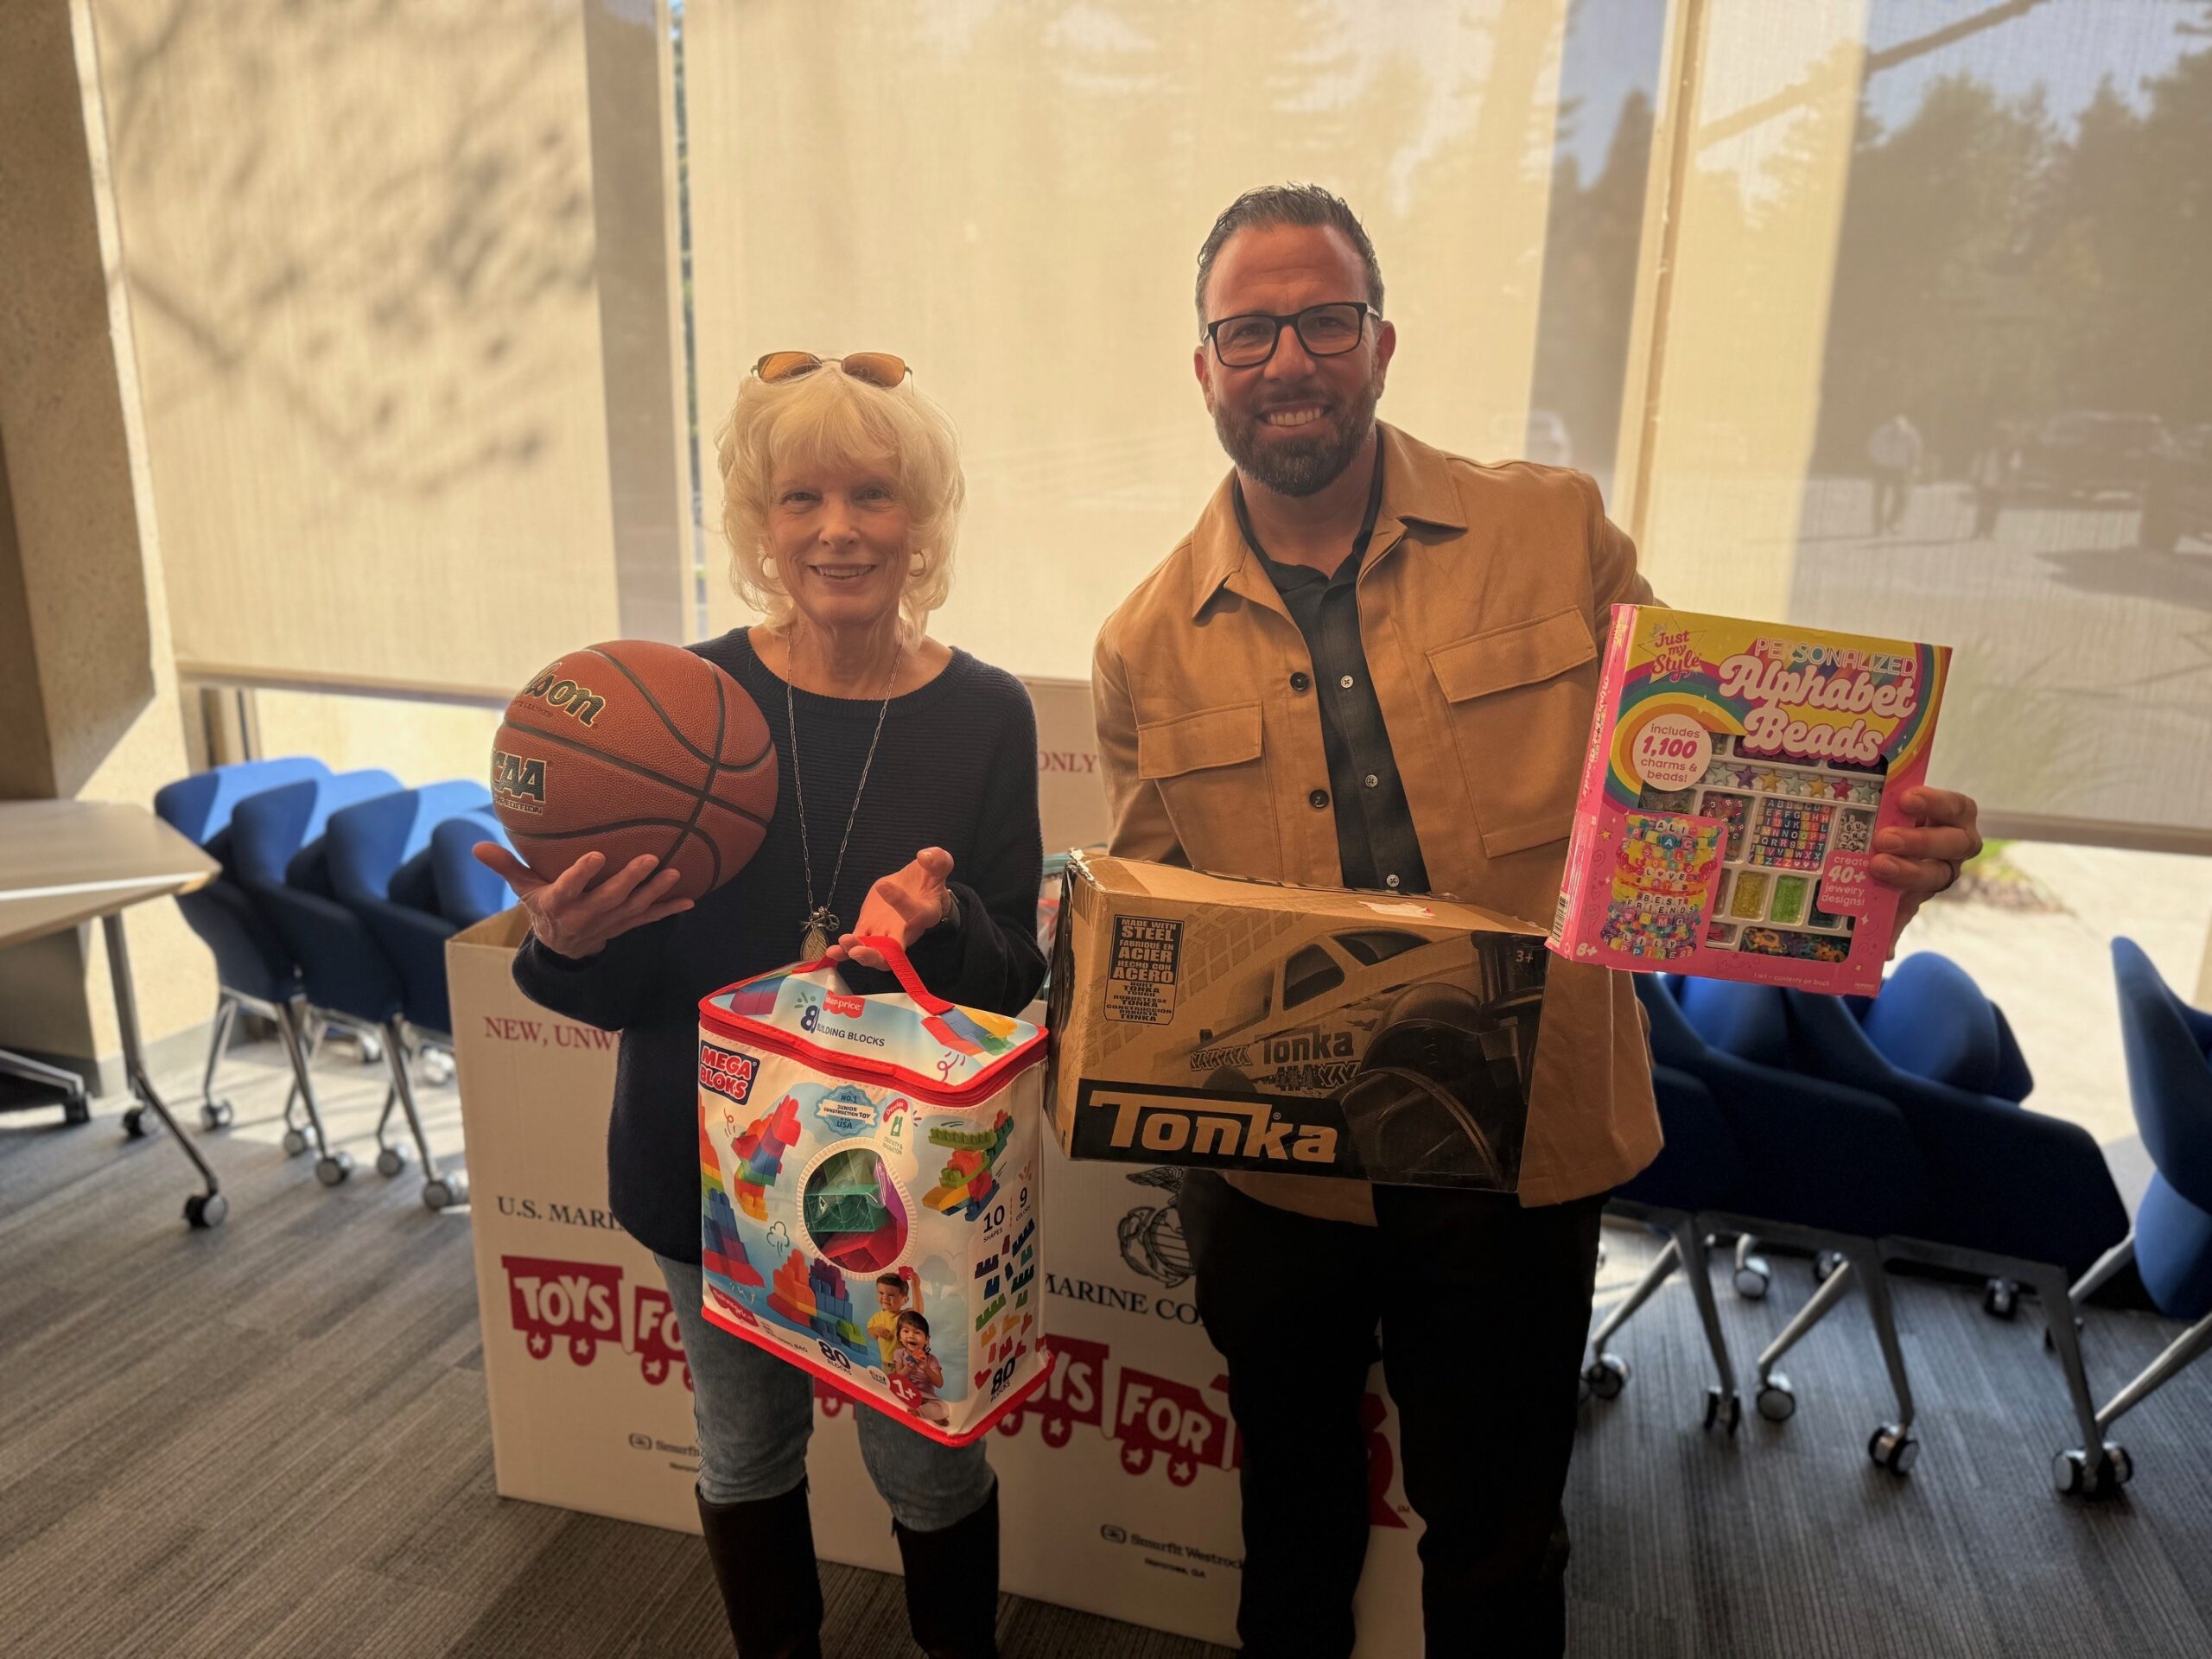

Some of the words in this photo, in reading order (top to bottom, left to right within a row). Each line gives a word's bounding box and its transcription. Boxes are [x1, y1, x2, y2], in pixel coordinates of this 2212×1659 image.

[1655, 630, 1690, 648] Just
[1668, 645, 1688, 657] my
[1754, 637, 1917, 677] PERSONALIZED
[1651, 650, 1702, 683] Style
[520, 661, 606, 728] lson
[1719, 653, 1917, 719] Alphabet
[1649, 723, 1700, 739] includes
[1742, 706, 1885, 762] Beads
[1642, 734, 1698, 760] 1,100
[1037, 750, 1097, 773] ONLY
[1641, 758, 1686, 771] charms
[1688, 763, 1698, 772] &
[493, 750, 547, 804] CAA
[1646, 769, 1688, 783] beads!
[1834, 856, 1870, 868] create
[1828, 865, 1866, 884] 40+
[1643, 894, 1685, 906] BEST
[1825, 883, 1866, 898] jewelry
[1821, 894, 1866, 907] designs!
[1122, 925, 1174, 942] STEEL
[1151, 921, 1177, 931] WITH
[1118, 946, 1173, 963] ACIER
[1516, 950, 1534, 963] 3+
[1112, 967, 1174, 983] ACERO
[1117, 960, 1149, 969] HECHO
[1152, 963, 1172, 971] CON
[1113, 995, 1167, 1003] ROBUSTESSE
[483, 1016, 549, 1048] NEW,
[552, 1024, 622, 1052] UNW
[847, 1032, 886, 1047] BLOCKS
[1254, 1024, 1355, 1065] Tonka
[700, 1045, 753, 1081] MEGA
[699, 1064, 749, 1101] BLOKS
[840, 1094, 858, 1103] NO.1
[823, 1107, 859, 1117] CONSTRUCTION
[836, 1120, 853, 1129] USA
[1089, 1090, 1338, 1164] Tonka
[1020, 1186, 1028, 1209] 9
[496, 1195, 543, 1220] U.S.
[549, 1202, 627, 1232] MARI
[982, 1205, 1006, 1234] 10
[982, 1227, 1004, 1243] SHAPES
[512, 1274, 614, 1332] TOYS
[638, 1298, 686, 1351] FO
[1155, 1298, 1206, 1328] CO
[818, 1340, 851, 1370] 80
[826, 1358, 853, 1376] BLOCKS
[990, 1357, 1016, 1395] 80
[892, 1379, 918, 1401] 1+
[1121, 1382, 1211, 1455] FOR
